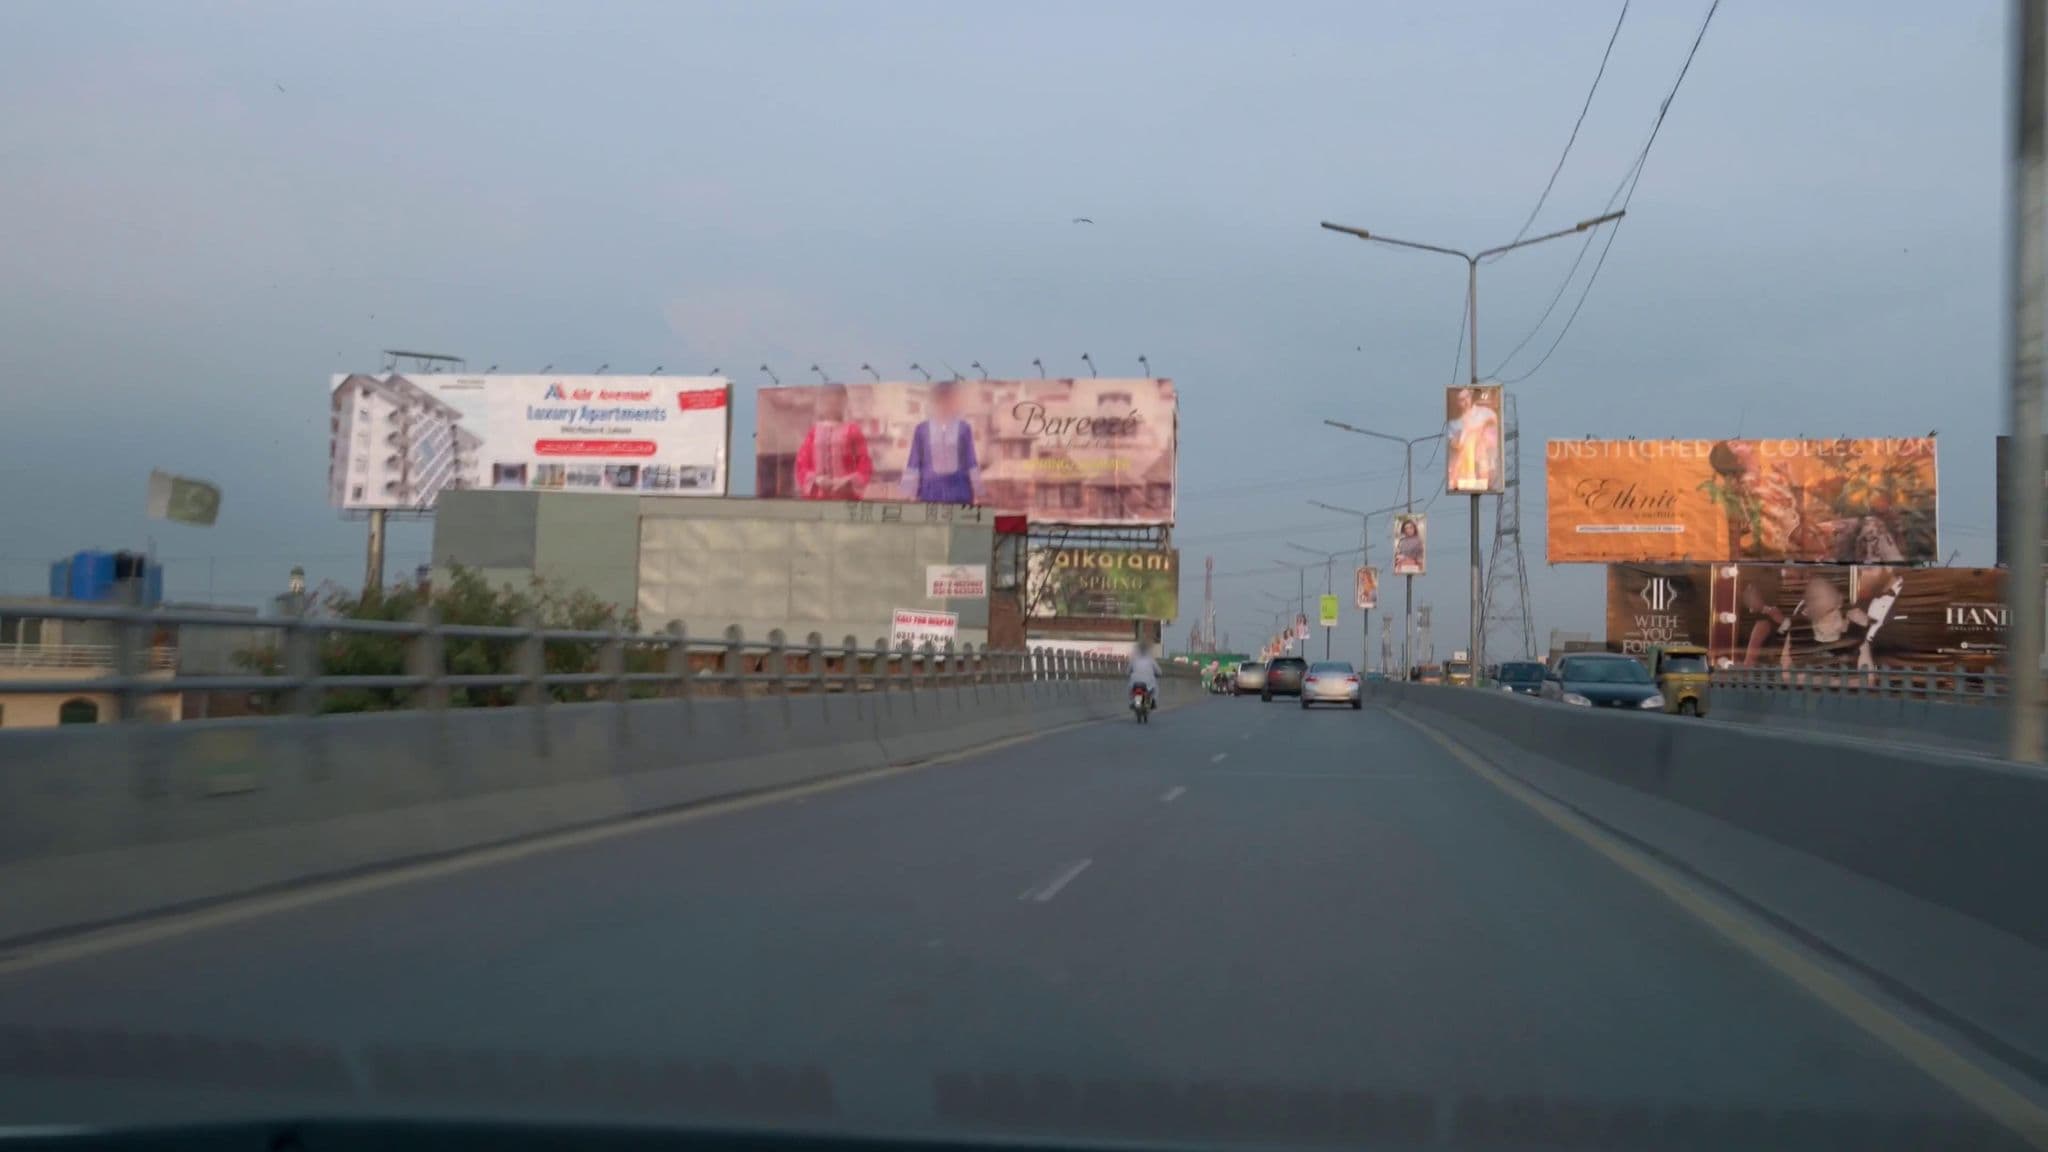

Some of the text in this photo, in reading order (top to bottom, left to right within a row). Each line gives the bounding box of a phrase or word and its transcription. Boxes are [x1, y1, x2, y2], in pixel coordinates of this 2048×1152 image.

[527, 405, 667, 424] Luxury Apartments
[1760, 438, 1936, 457] COLLECTION
[1575, 478, 1678, 512] Ethnic
[1080, 575, 1143, 591] SPRING
[1634, 614, 1678, 628] WITH
[1641, 628, 1673, 641] YOU
